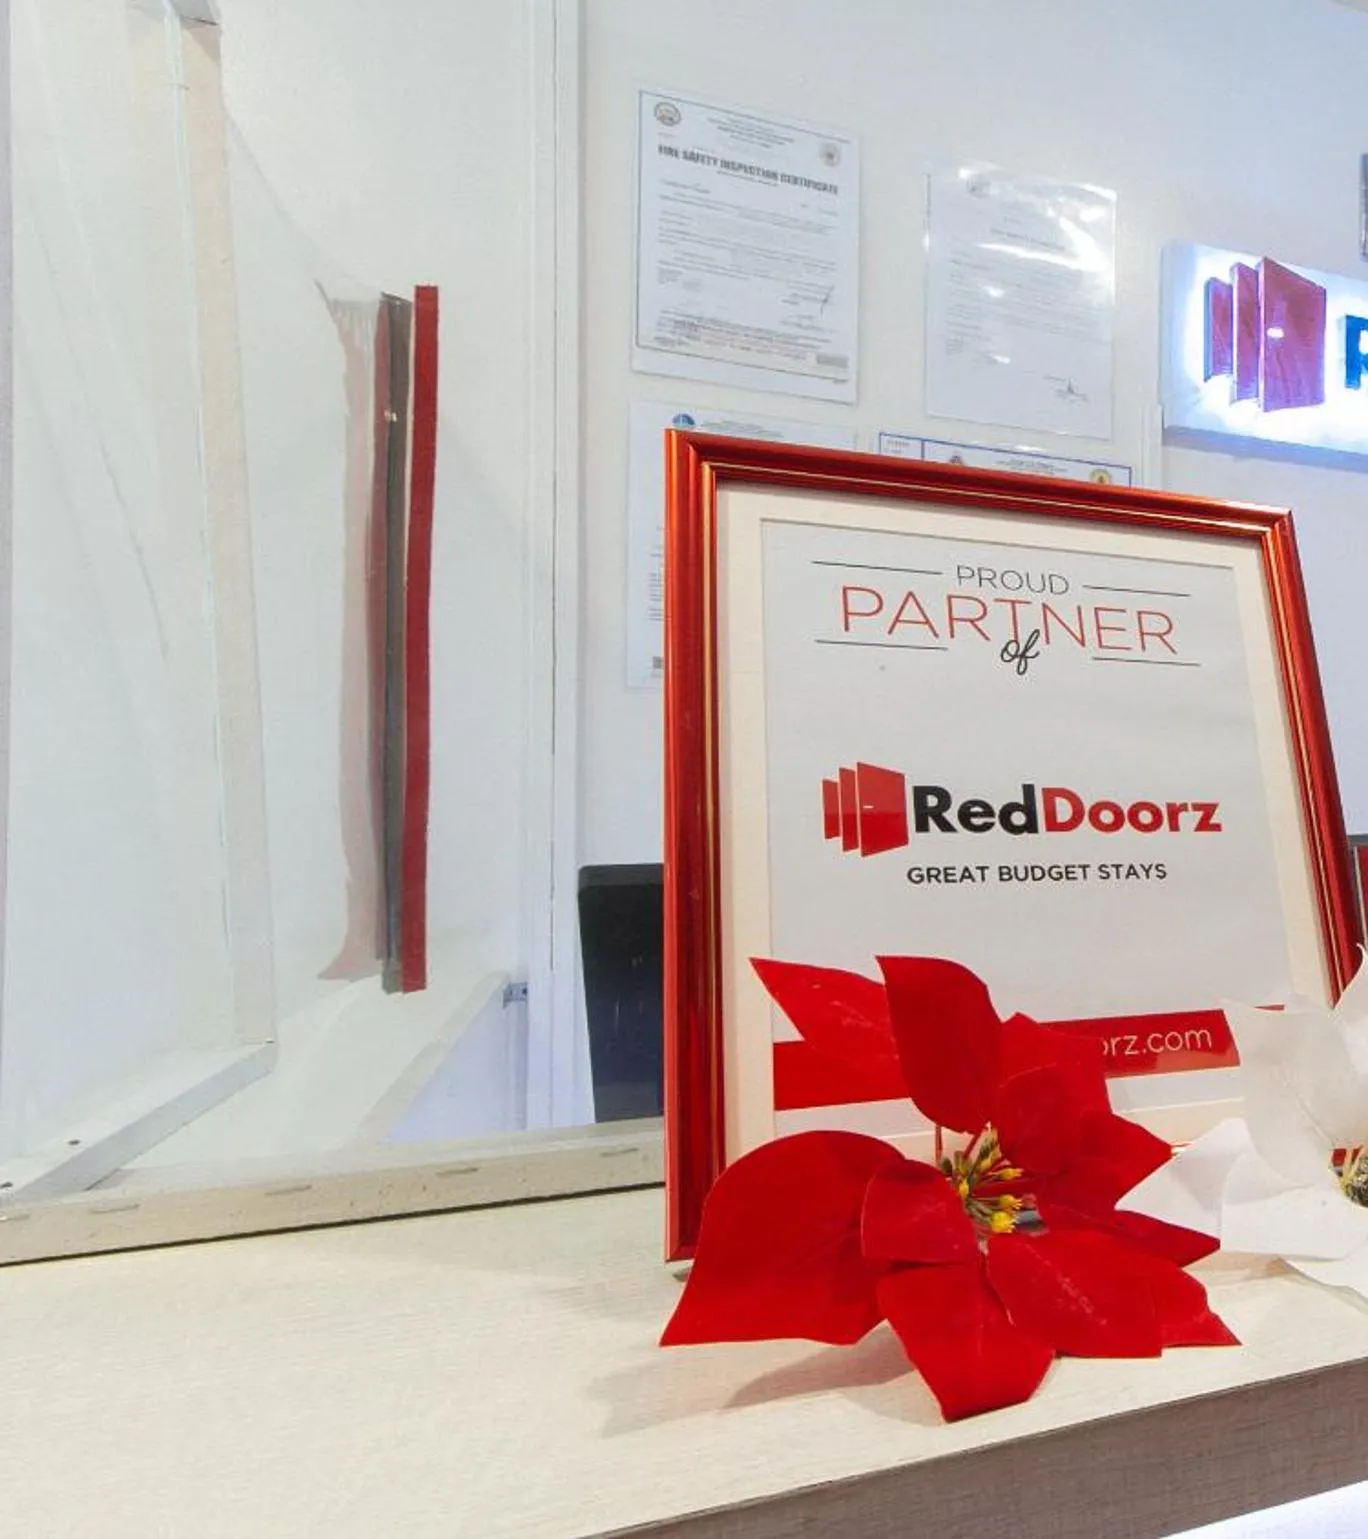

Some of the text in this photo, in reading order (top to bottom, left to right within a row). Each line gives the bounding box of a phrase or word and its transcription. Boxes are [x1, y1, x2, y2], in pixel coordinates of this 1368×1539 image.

[658, 143, 681, 160] FIRE
[682, 150, 720, 168] SAFETY
[720, 158, 779, 180] INSPECTION
[780, 172, 839, 196] CERTIFICATE
[956, 565, 1070, 595] PROUD
[842, 585, 1177, 654] PARTNER
[1000, 629, 1040, 675] of
[913, 783, 1222, 835] RedDoorz
[907, 863, 1168, 885] GREAT BUDGET STAYS
